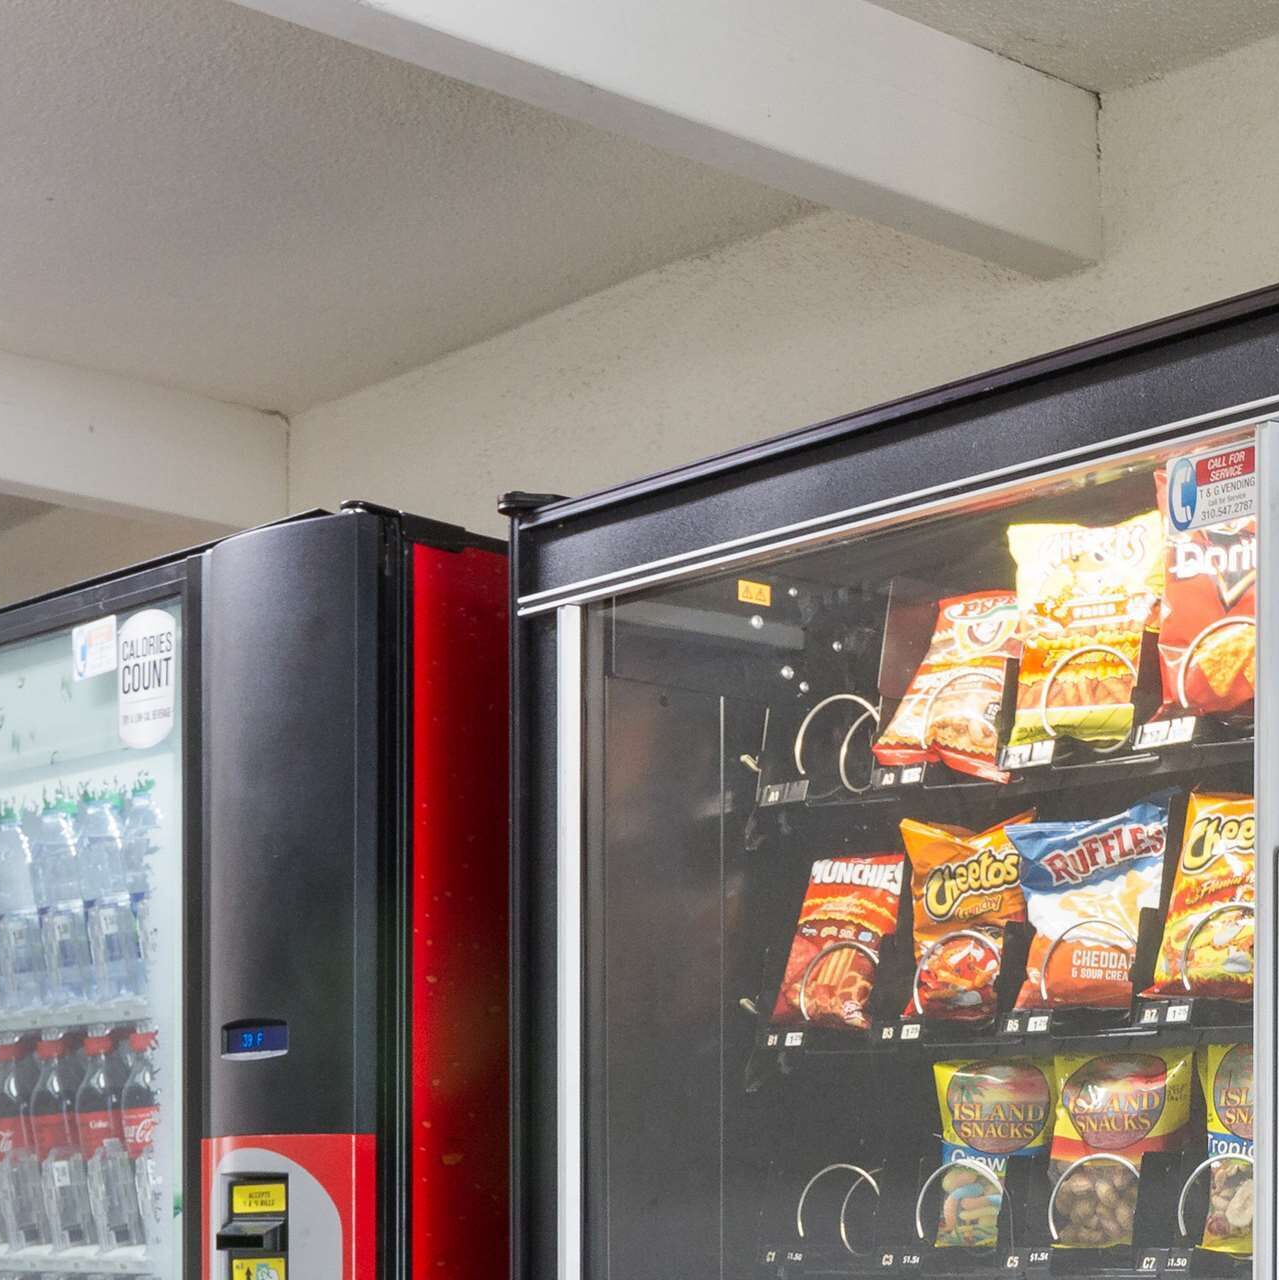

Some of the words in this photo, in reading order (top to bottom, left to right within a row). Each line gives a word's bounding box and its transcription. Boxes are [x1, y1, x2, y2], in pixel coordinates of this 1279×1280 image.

[1207, 456, 1226, 470] CALL
[1228, 451, 1246, 465] FOR
[1210, 464, 1243, 481] SERVICE
[1221, 477, 1256, 494] VENDING
[122, 631, 172, 661] CALORIES
[122, 657, 172, 694] COUNT
[1042, 824, 1167, 888] RUFFLES
[811, 858, 904, 895] MUNCHIES
[925, 851, 1020, 919] Cheetos
[955, 895, 1002, 919] Crunchy
[1080, 970, 1103, 979] SOUR
[882, 1026, 894, 1039] B3
[1006, 1019, 1020, 1032] B5
[768, 1034, 778, 1047] B1
[1070, 1091, 1161, 1114] ISLAND
[953, 1104, 1045, 1121] ISLAND
[960, 1121, 1035, 1138] SNACKS
[1074, 1112, 1153, 1132] SNACKS
[766, 1251, 776, 1263] C1
[882, 1254, 894, 1266] C3
[1006, 1255, 1019, 1268] C5
[1142, 1256, 1156, 1269] C7
